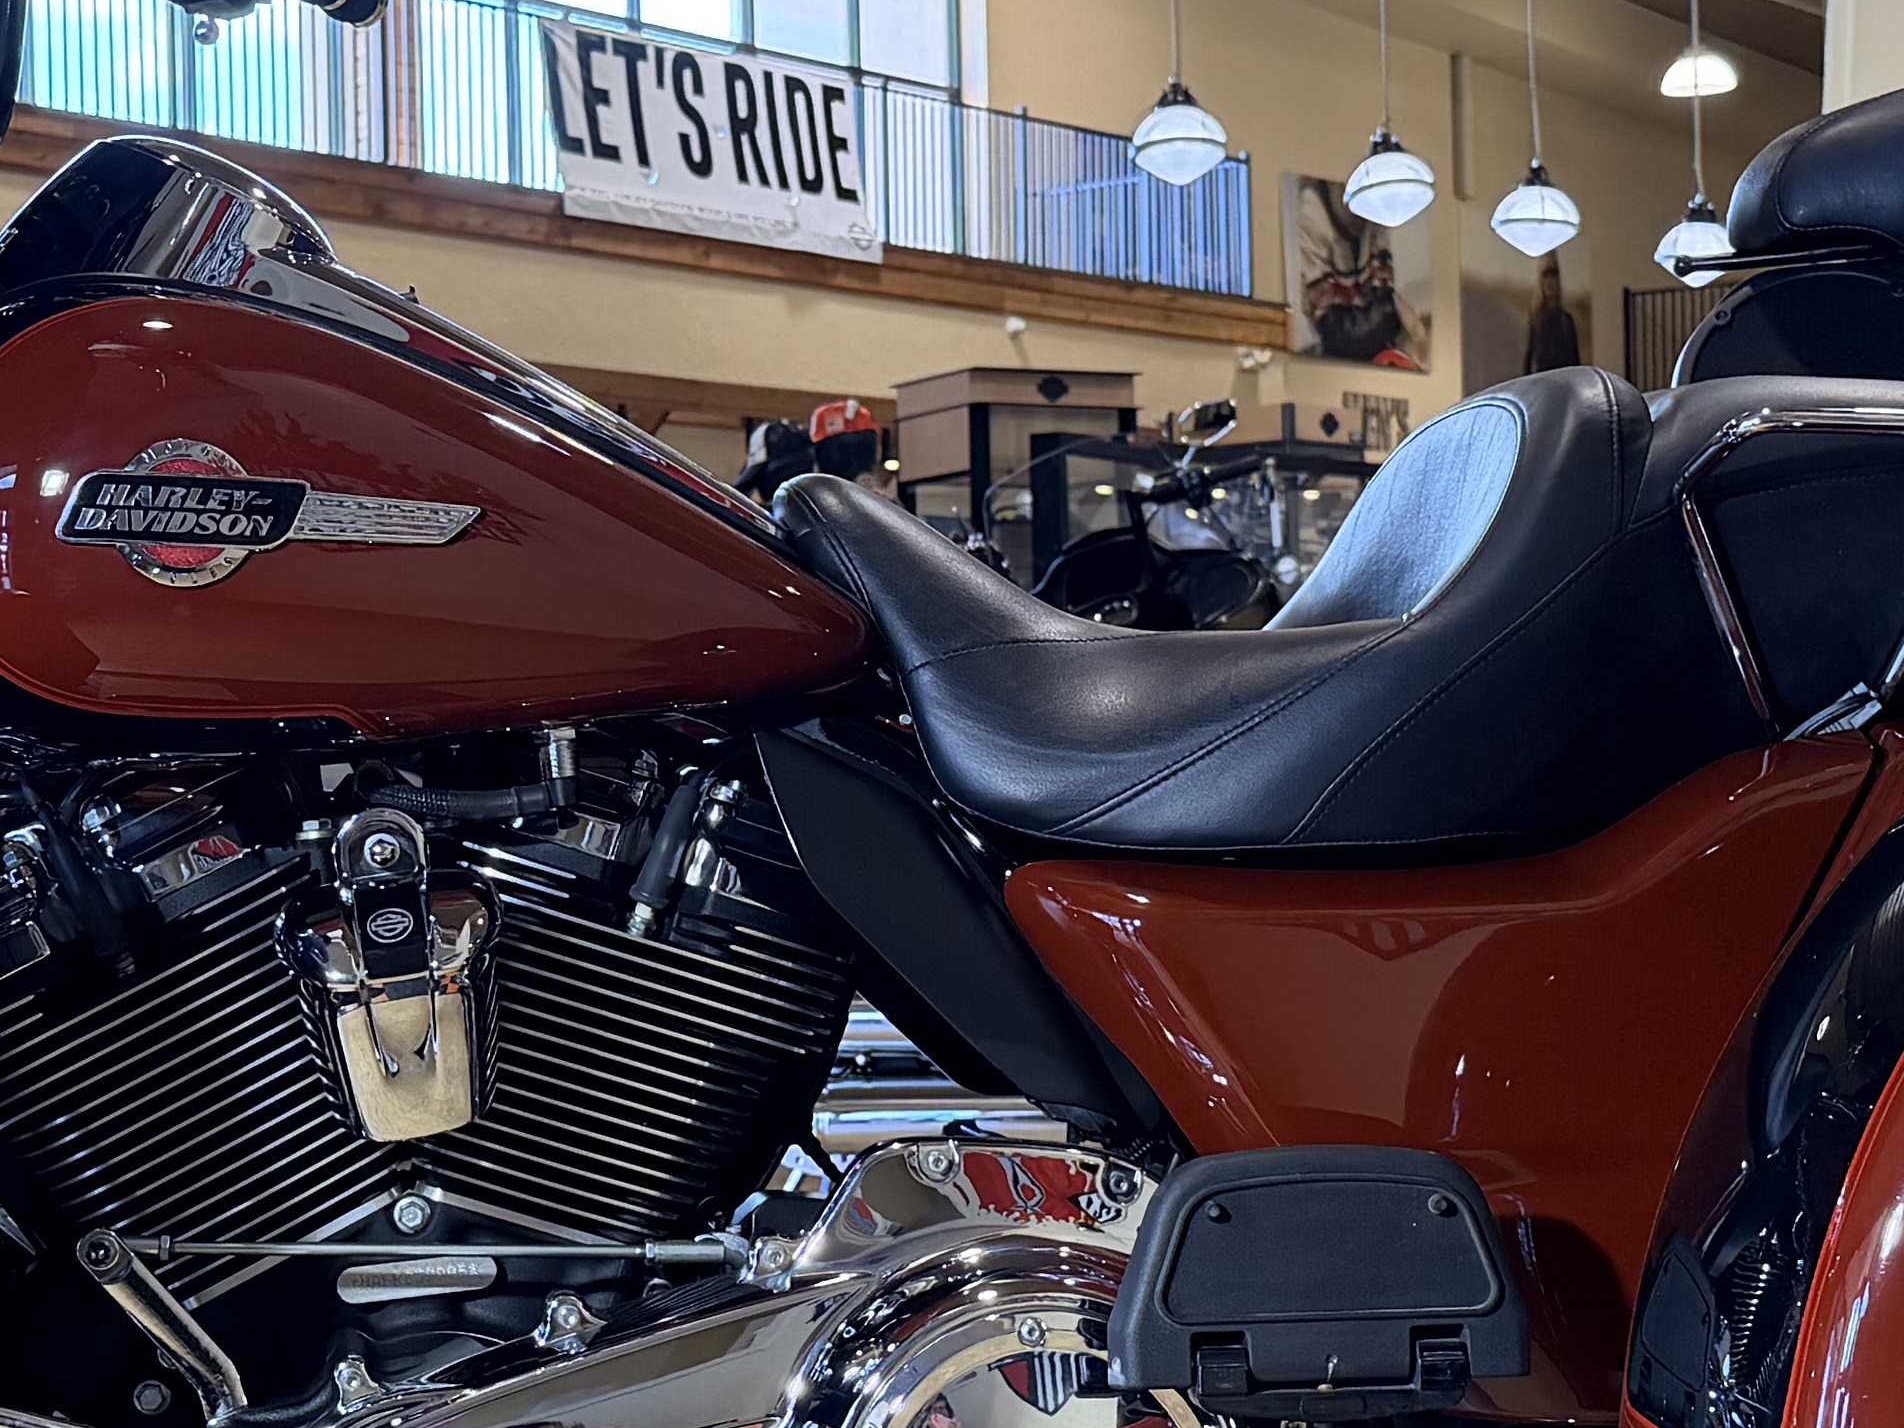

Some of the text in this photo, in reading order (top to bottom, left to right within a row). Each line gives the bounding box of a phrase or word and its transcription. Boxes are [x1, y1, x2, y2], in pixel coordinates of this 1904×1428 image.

[542, 25, 860, 204] LET'S RIDE
[96, 483, 273, 512] HARLEY-
[73, 507, 274, 538] DAVIDSON
